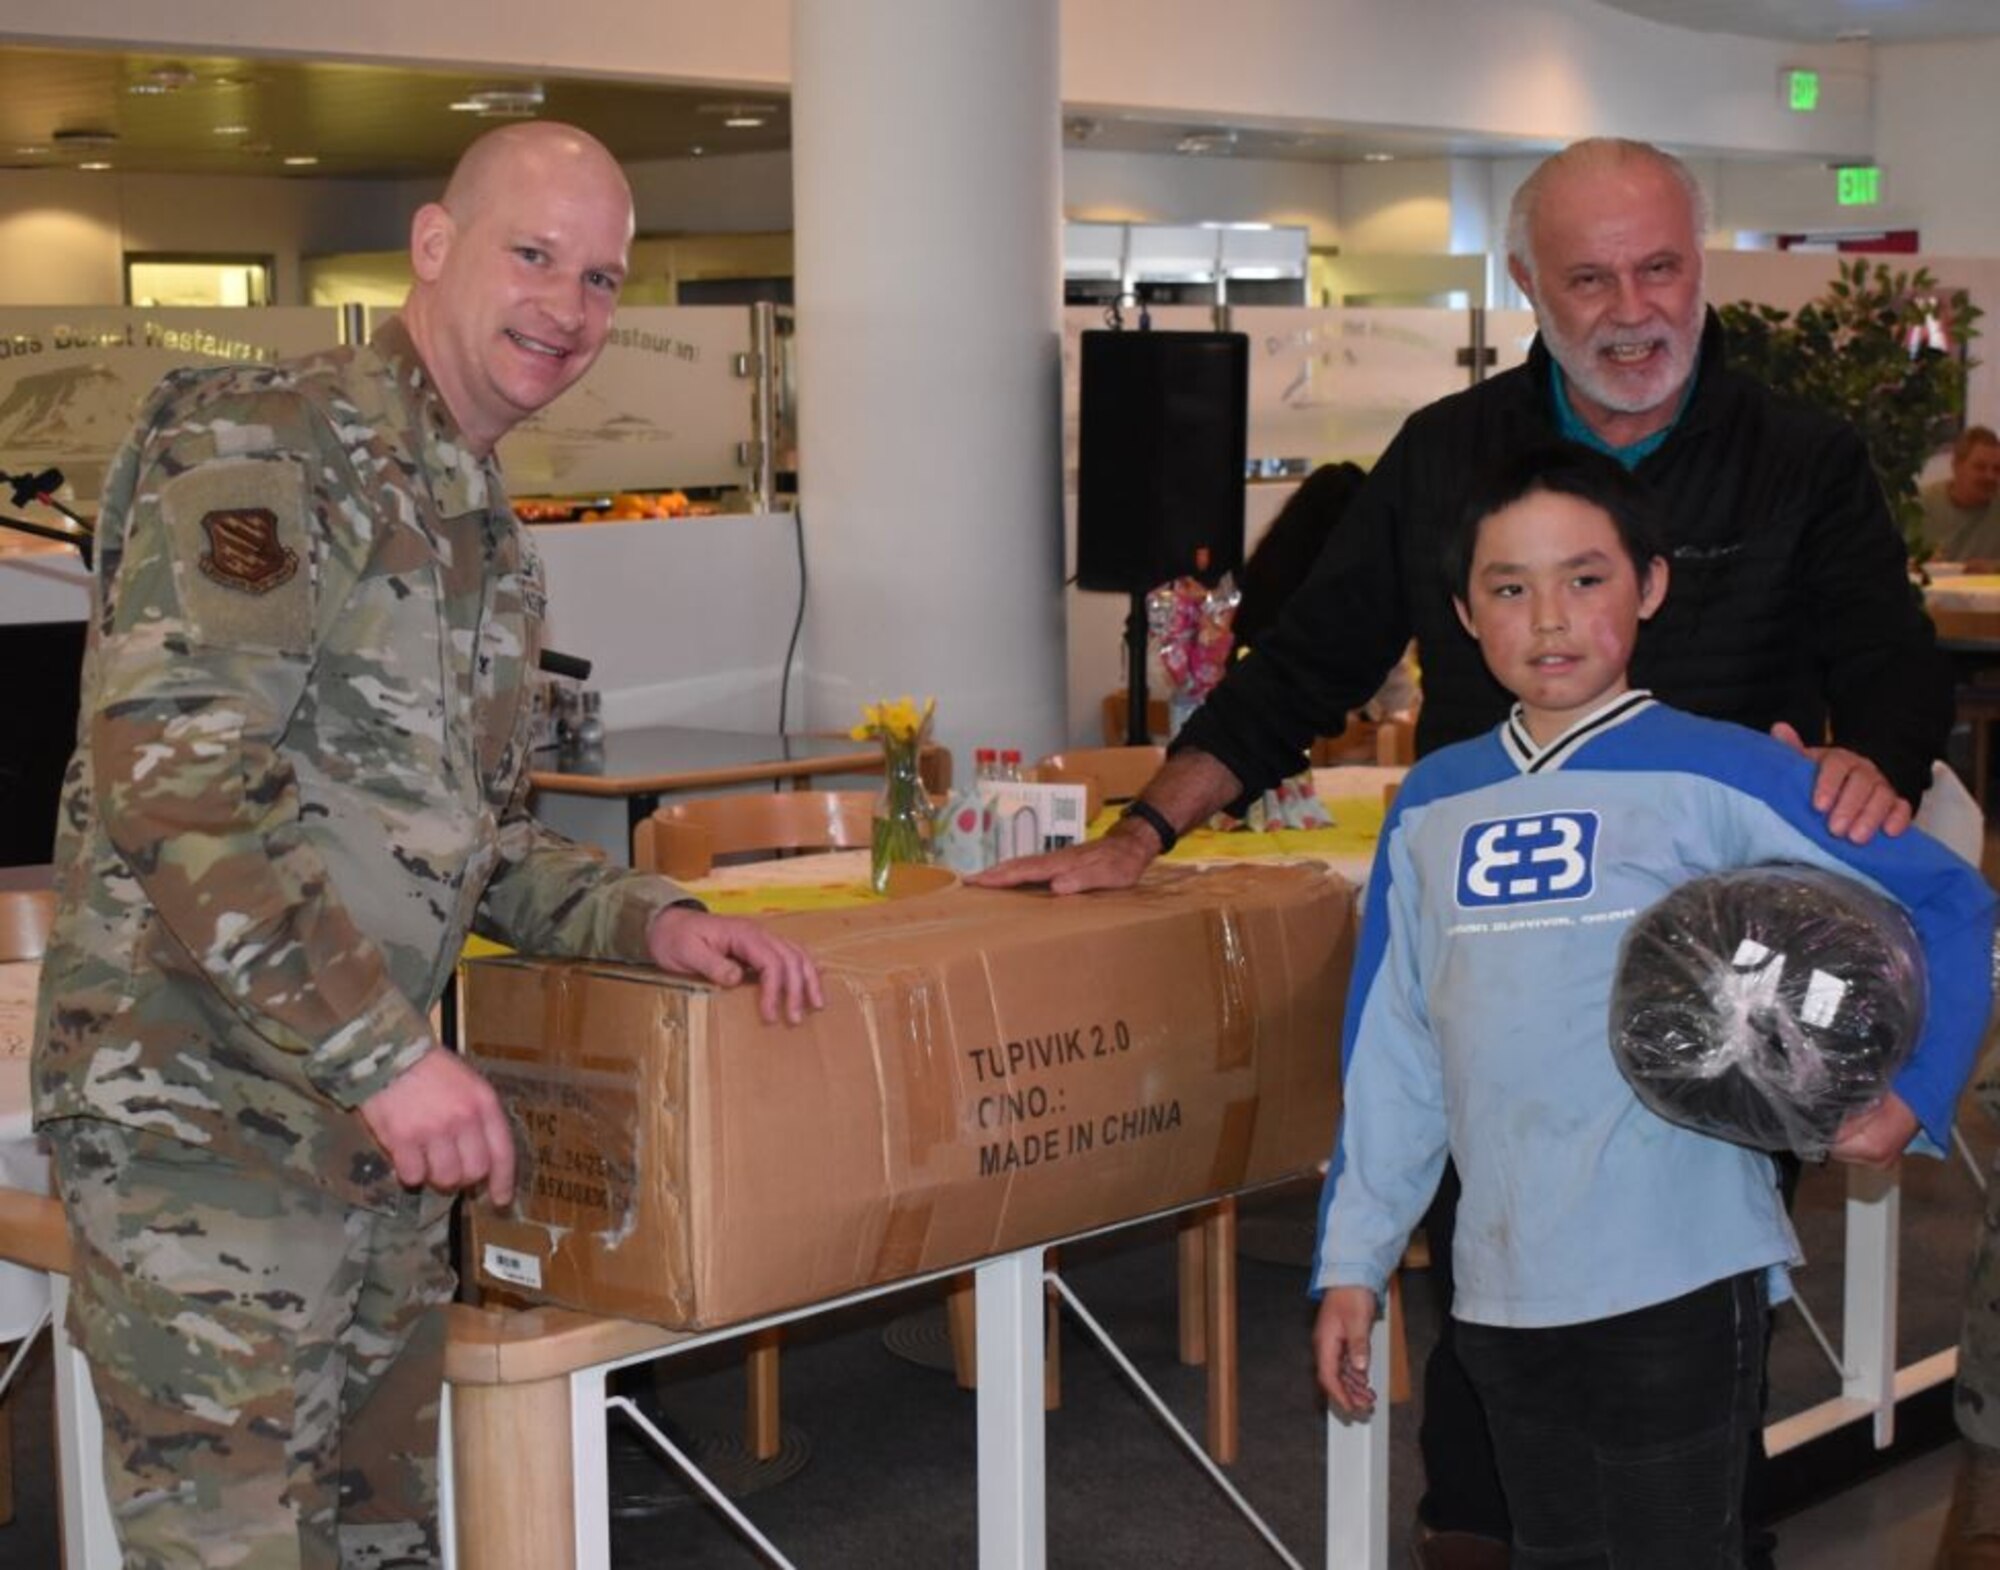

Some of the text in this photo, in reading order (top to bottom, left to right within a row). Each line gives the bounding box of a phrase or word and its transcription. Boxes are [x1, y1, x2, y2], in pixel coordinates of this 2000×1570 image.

[968, 1020, 1131, 1082] TUPIVIK 2.0
[980, 1100, 1182, 1176] MADE IN CHINA
